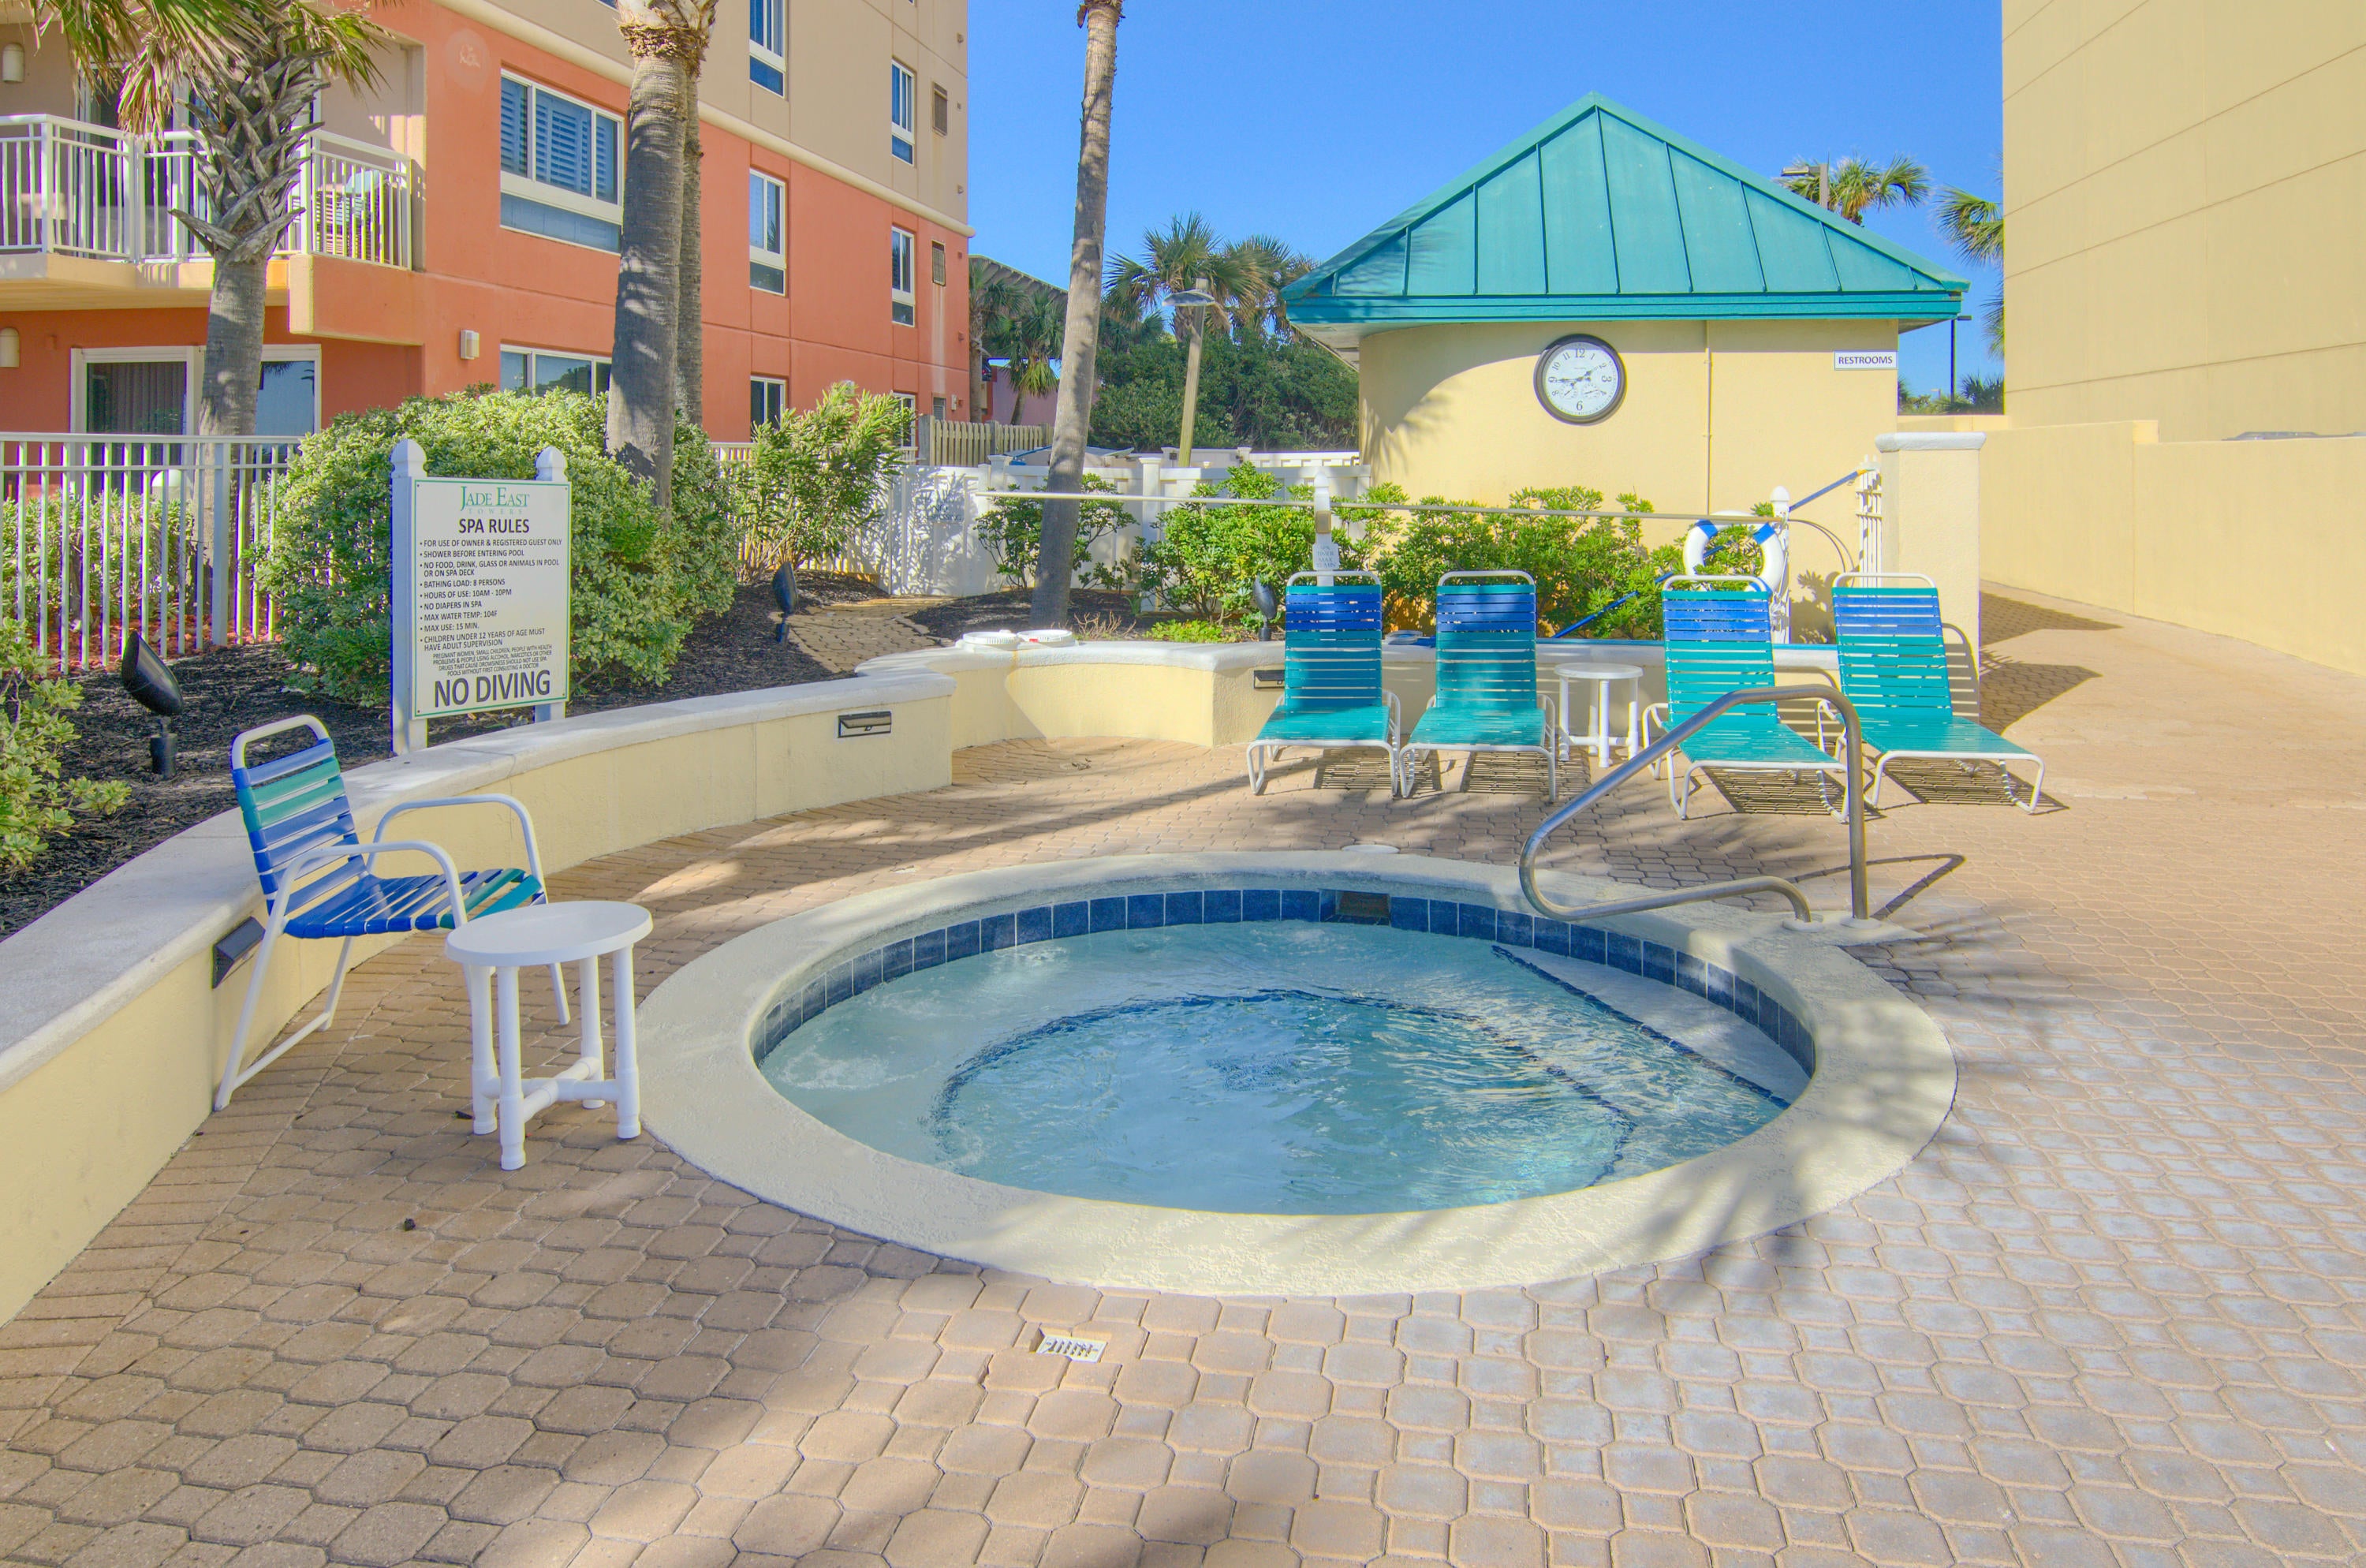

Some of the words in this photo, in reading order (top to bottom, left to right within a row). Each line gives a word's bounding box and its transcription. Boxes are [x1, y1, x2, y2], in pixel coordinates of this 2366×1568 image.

[1575, 348, 1586, 358] 12
[1838, 356, 1893, 364] RESTROOMS
[1552, 362, 1561, 370] 10
[1576, 400, 1583, 411] 6
[460, 486, 493, 511] JADE
[496, 487, 530, 507] EAST
[459, 518, 485, 533] SPA
[489, 519, 530, 533] RULES
[436, 601, 461, 610] DIAPERS
[424, 635, 455, 644] CHILDREN
[456, 633, 478, 641] UNDER
[442, 642, 462, 651] ADULT
[463, 639, 503, 649] SUPERVISION
[435, 678, 469, 708] NO
[476, 669, 550, 703] DIVING
